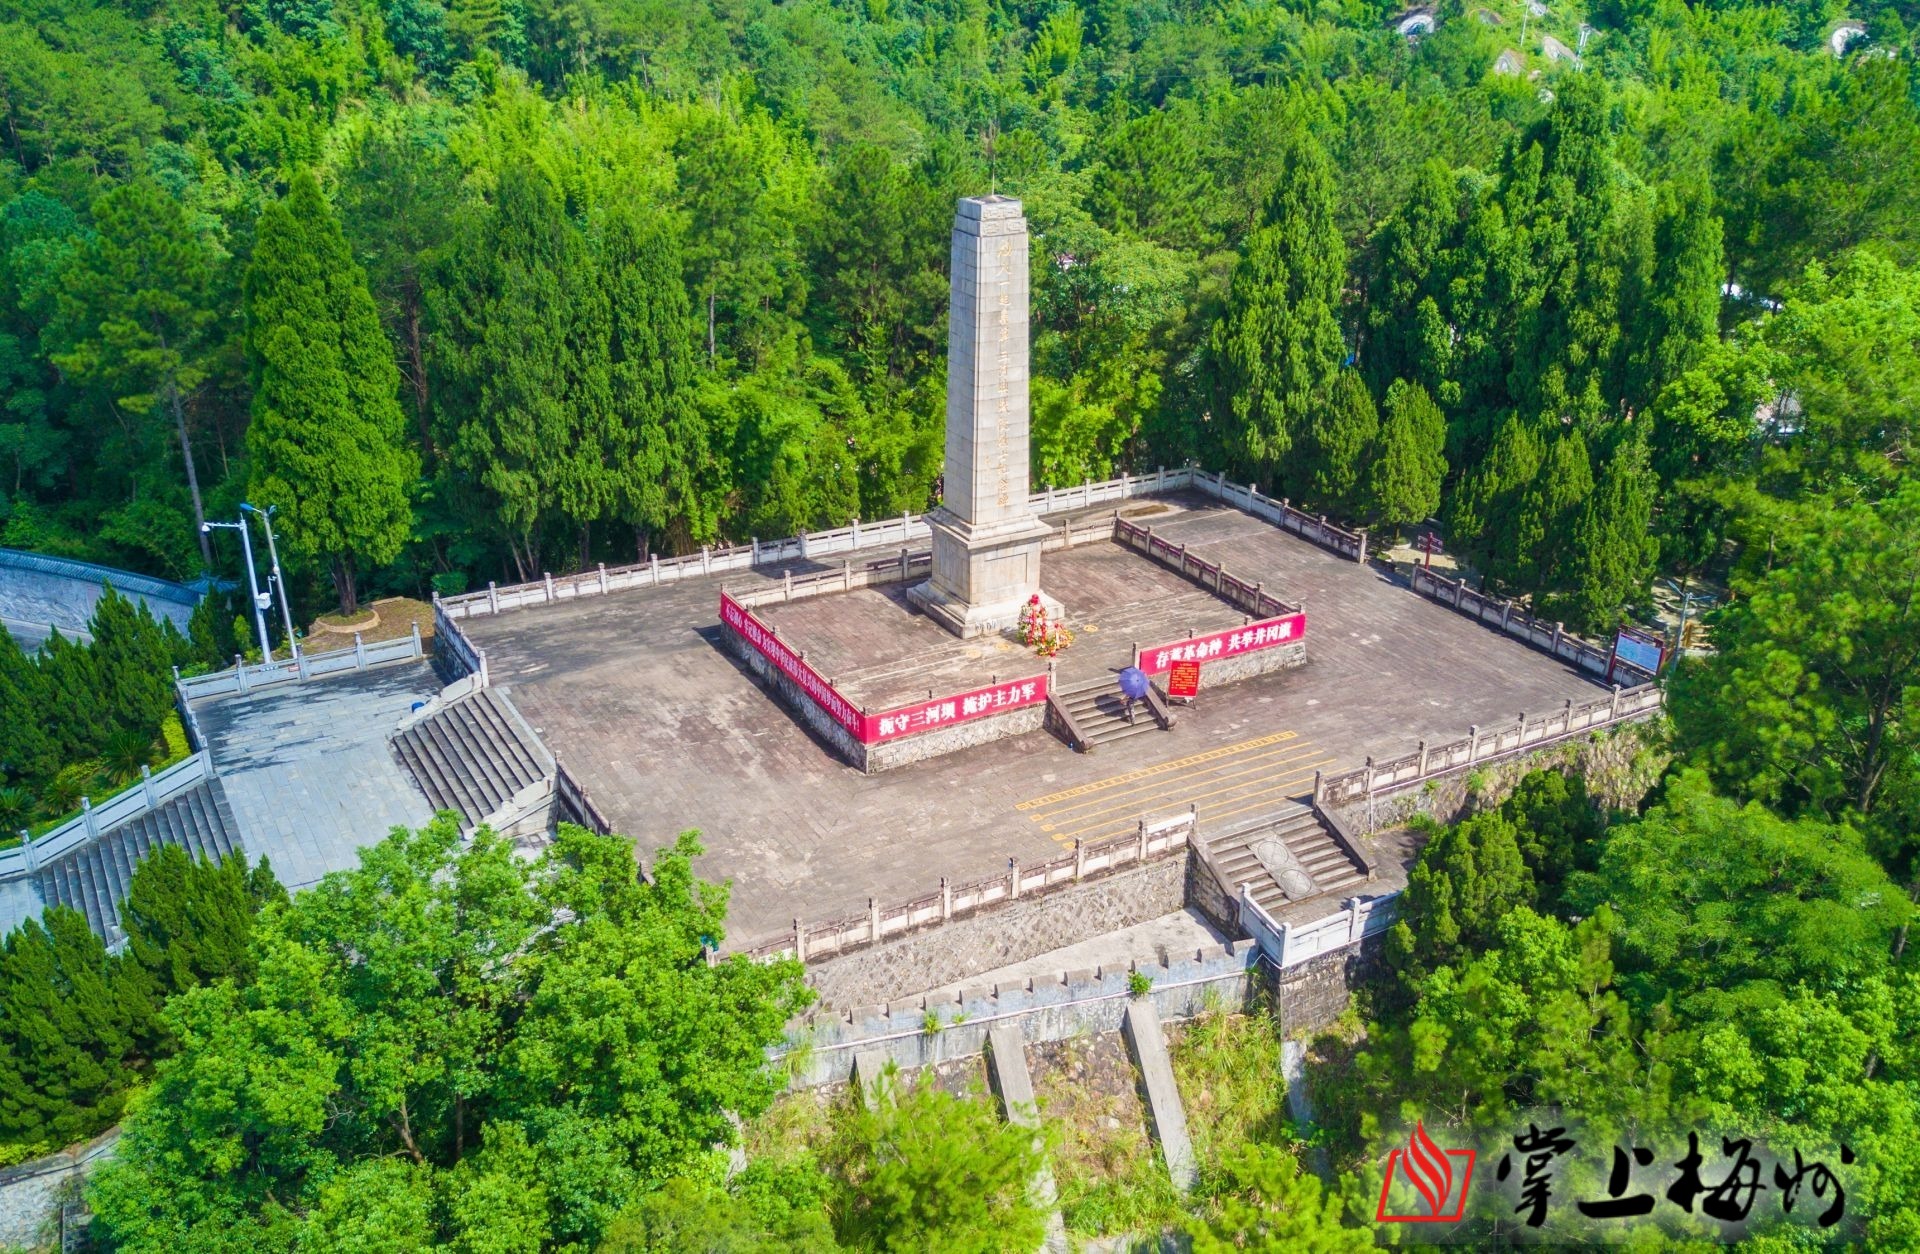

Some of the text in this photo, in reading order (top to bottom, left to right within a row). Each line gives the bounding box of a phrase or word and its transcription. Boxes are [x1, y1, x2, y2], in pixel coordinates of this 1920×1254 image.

[1228, 622, 1292, 650] 共举井冈旗
[879, 682, 1036, 736] 扼守三河坝 掩护主力军
